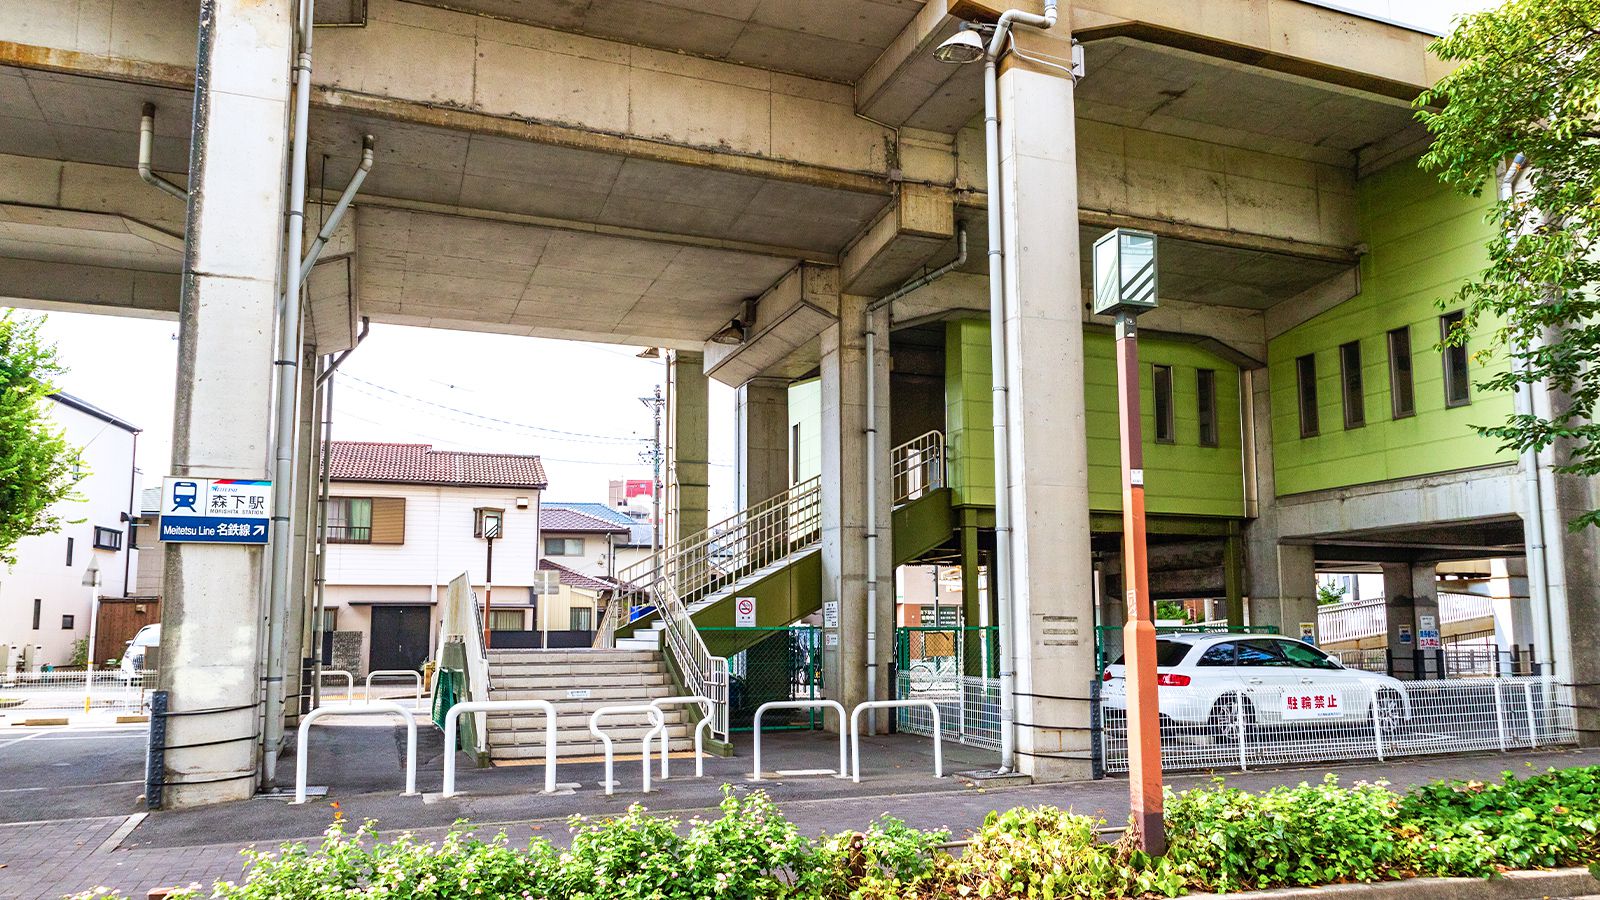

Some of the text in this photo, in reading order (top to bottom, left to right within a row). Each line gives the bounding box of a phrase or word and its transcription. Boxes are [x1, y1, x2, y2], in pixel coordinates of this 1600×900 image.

[211, 494, 264, 510] 森下駅
[163, 523, 251, 537] Meitetsu Line 名鉄線
[1286, 694, 1338, 710] 駐輪禁止
